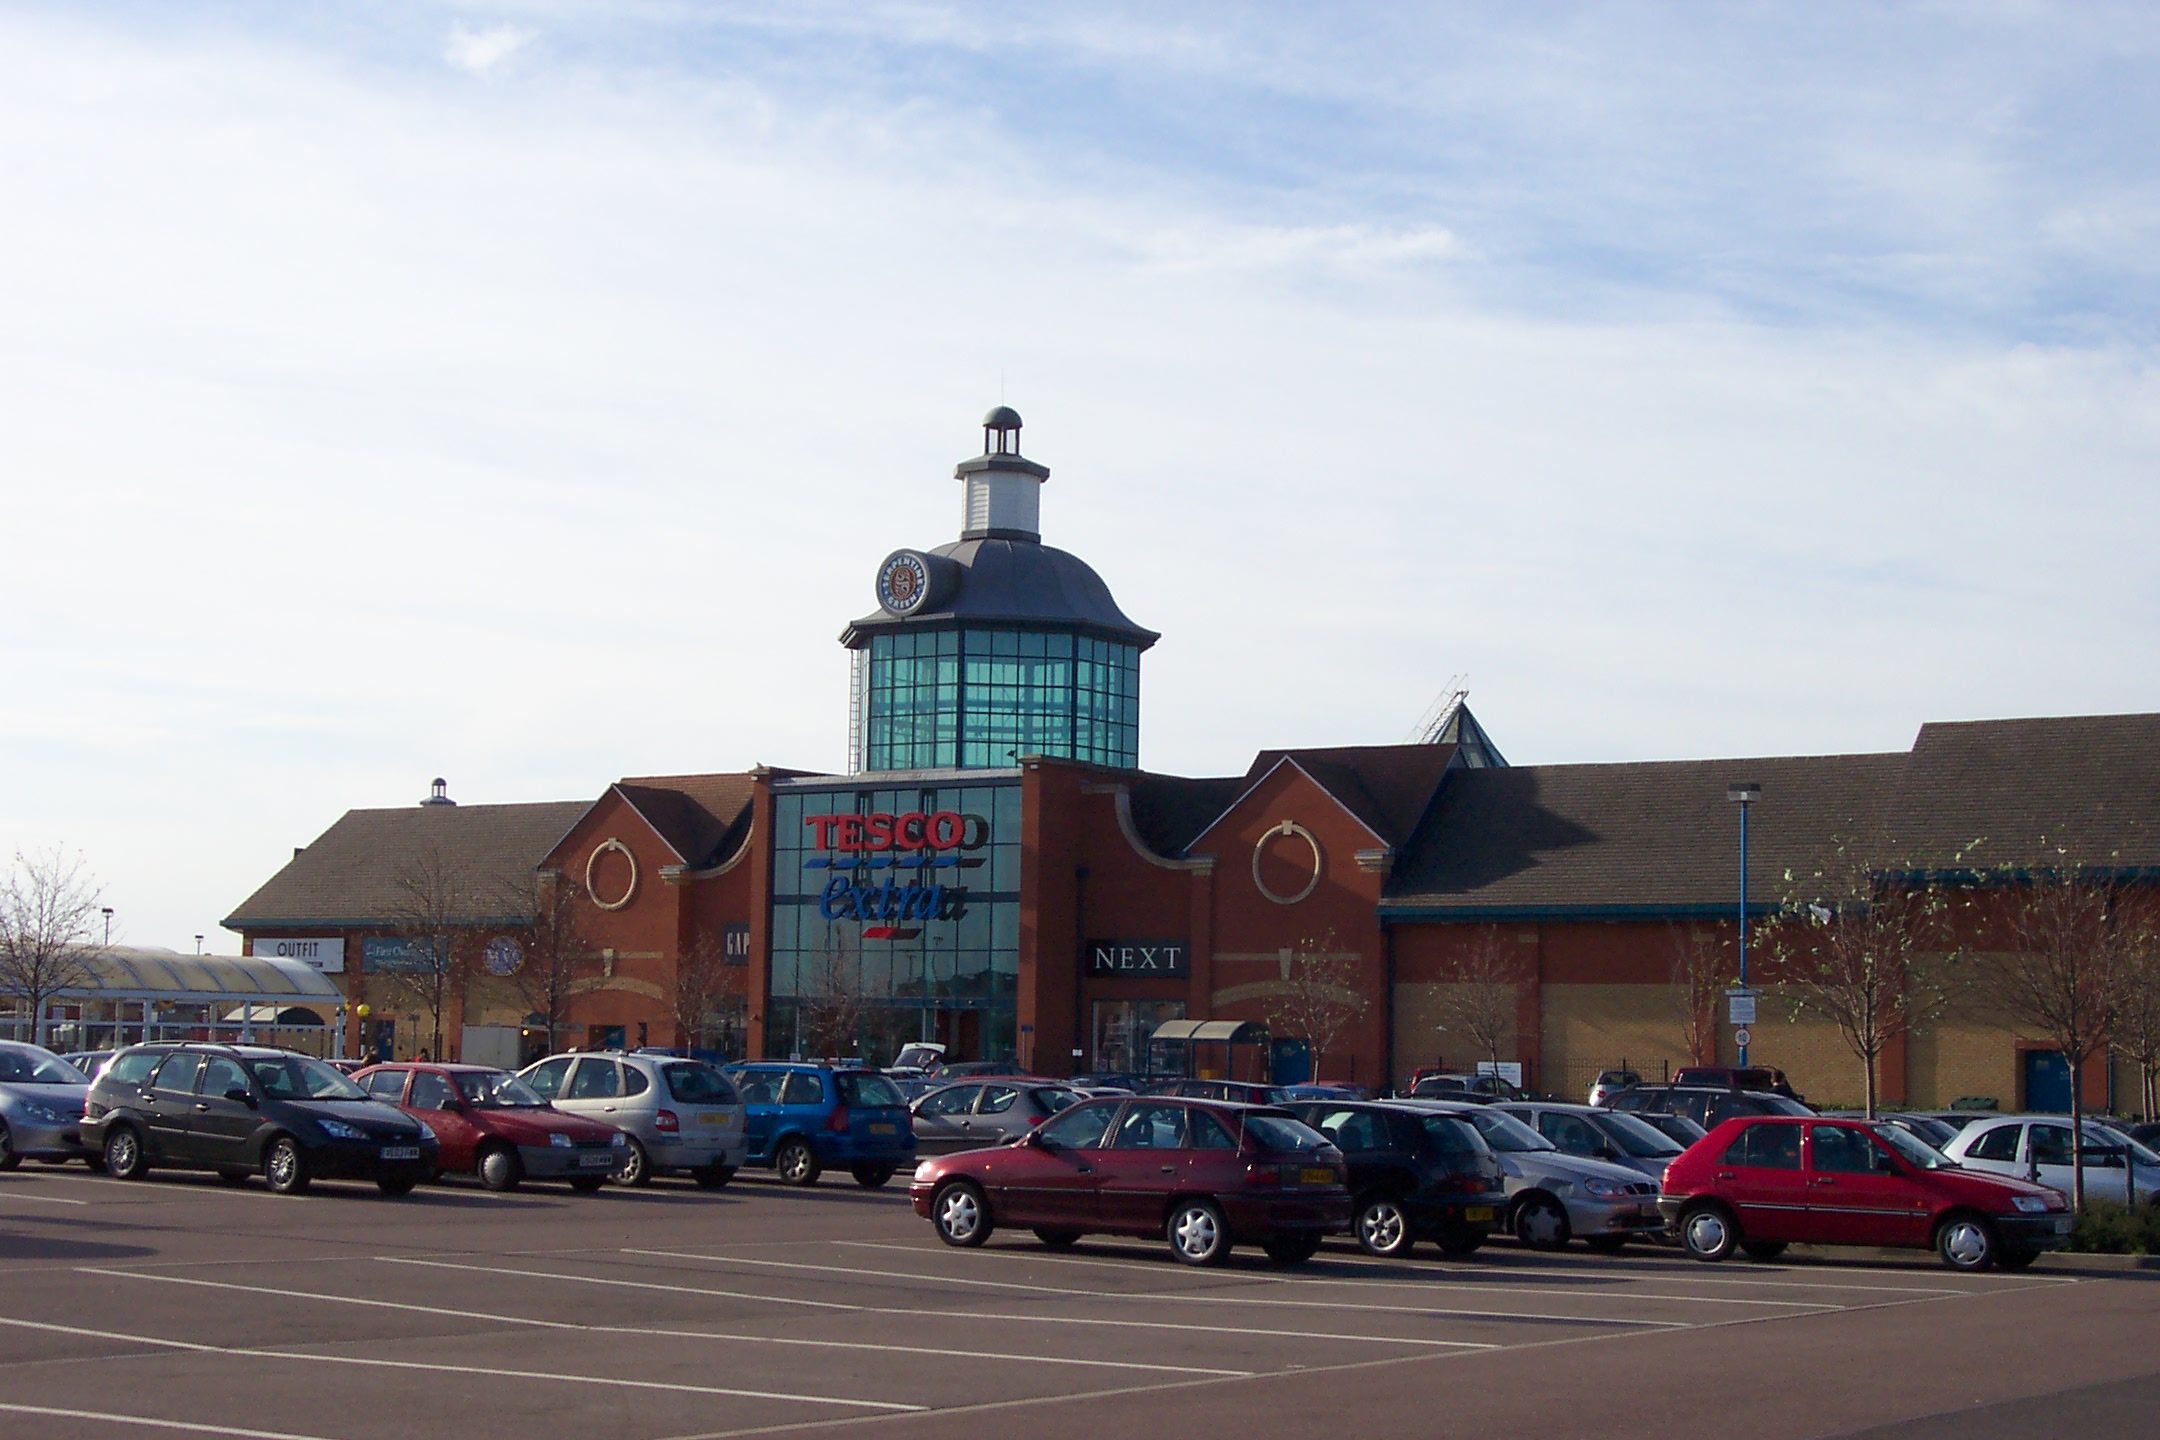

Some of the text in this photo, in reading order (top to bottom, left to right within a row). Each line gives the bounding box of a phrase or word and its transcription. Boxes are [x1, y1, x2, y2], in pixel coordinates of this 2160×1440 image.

[887, 594, 917, 609] GREEN
[806, 811, 966, 852] TESCO
[819, 876, 944, 921] extra
[277, 942, 319, 957] OUTFIT
[1095, 947, 1181, 969] NEXT
